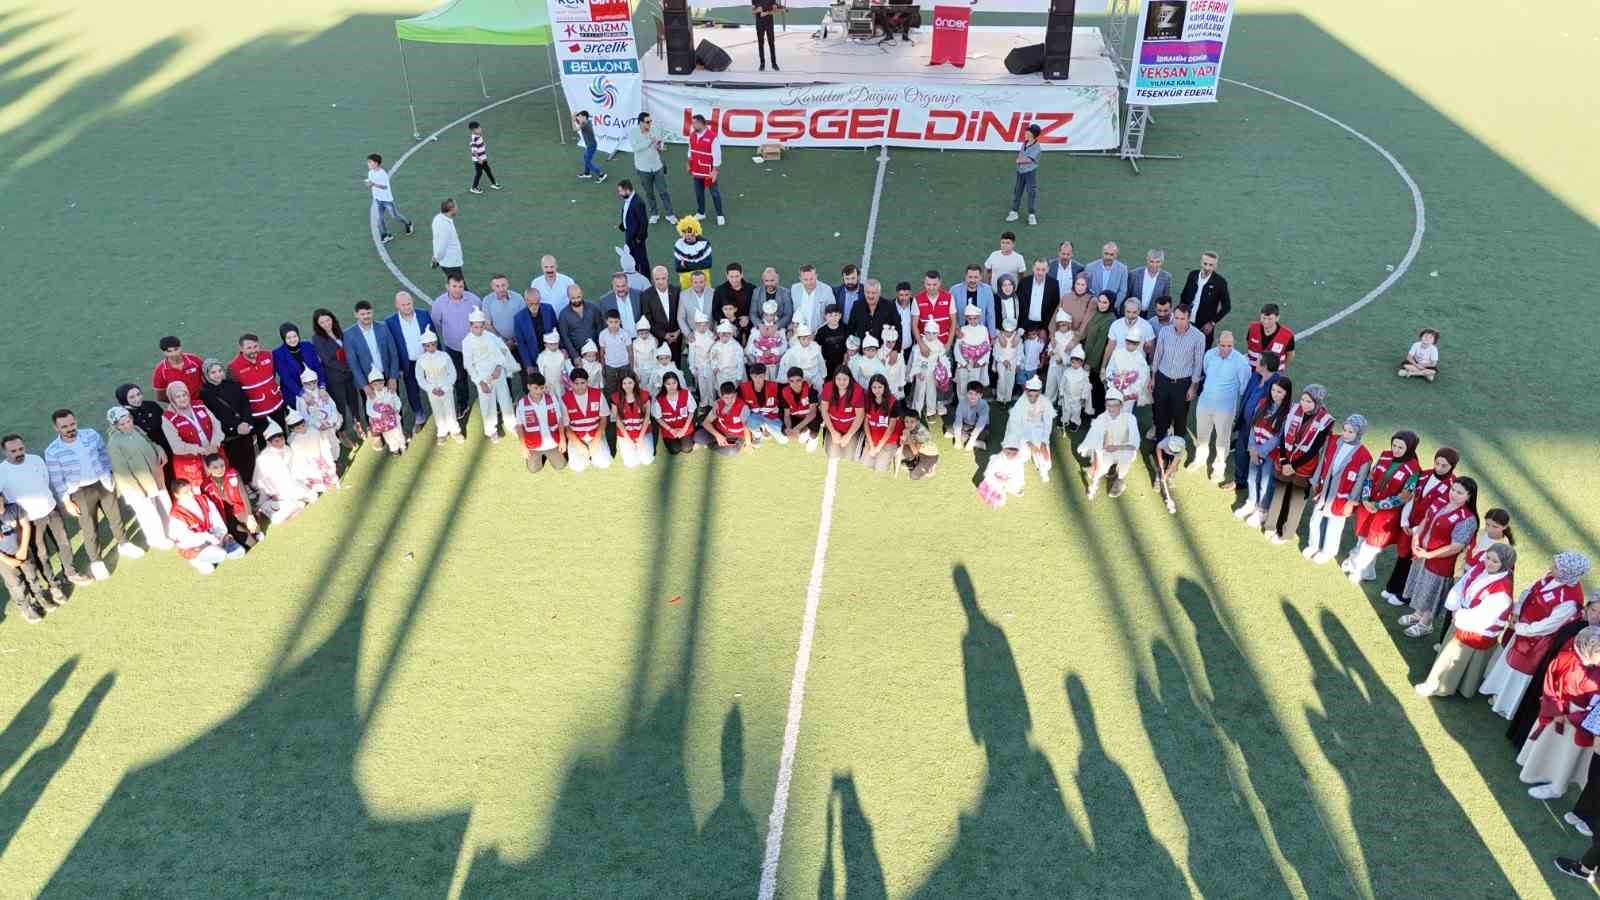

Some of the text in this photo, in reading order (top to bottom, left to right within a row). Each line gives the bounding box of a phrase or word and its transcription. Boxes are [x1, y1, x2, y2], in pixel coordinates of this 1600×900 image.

[583, 42, 630, 55] arçelik
[571, 61, 633, 73] BELLONA
[1192, 65, 1217, 77] YAPI
[780, 87, 844, 106] Kardelen
[1136, 88, 1184, 98] TEŞEKKÜR
